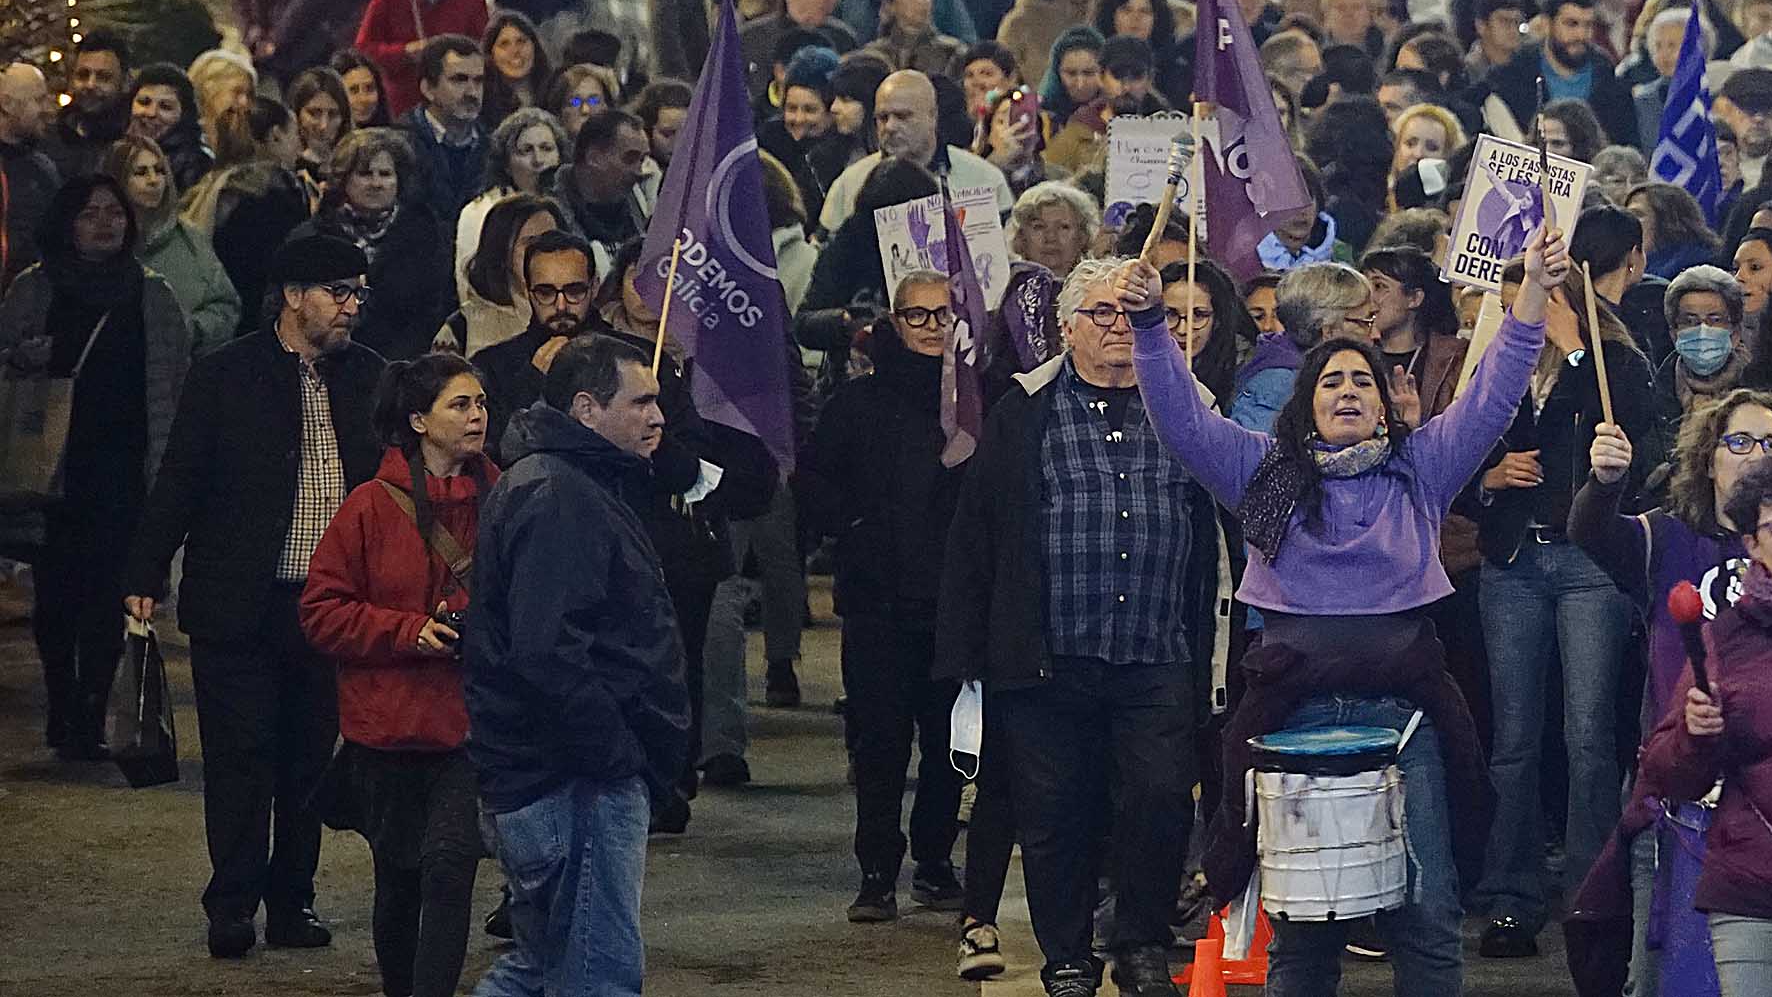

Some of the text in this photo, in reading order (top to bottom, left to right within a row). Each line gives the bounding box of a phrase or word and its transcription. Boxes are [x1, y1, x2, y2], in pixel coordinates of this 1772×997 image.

[1489, 150, 1577, 183] A LOS FASISTAS
[1508, 167, 1534, 187] LES
[1466, 232, 1504, 260] CON
[674, 227, 764, 328] ODEMOS
